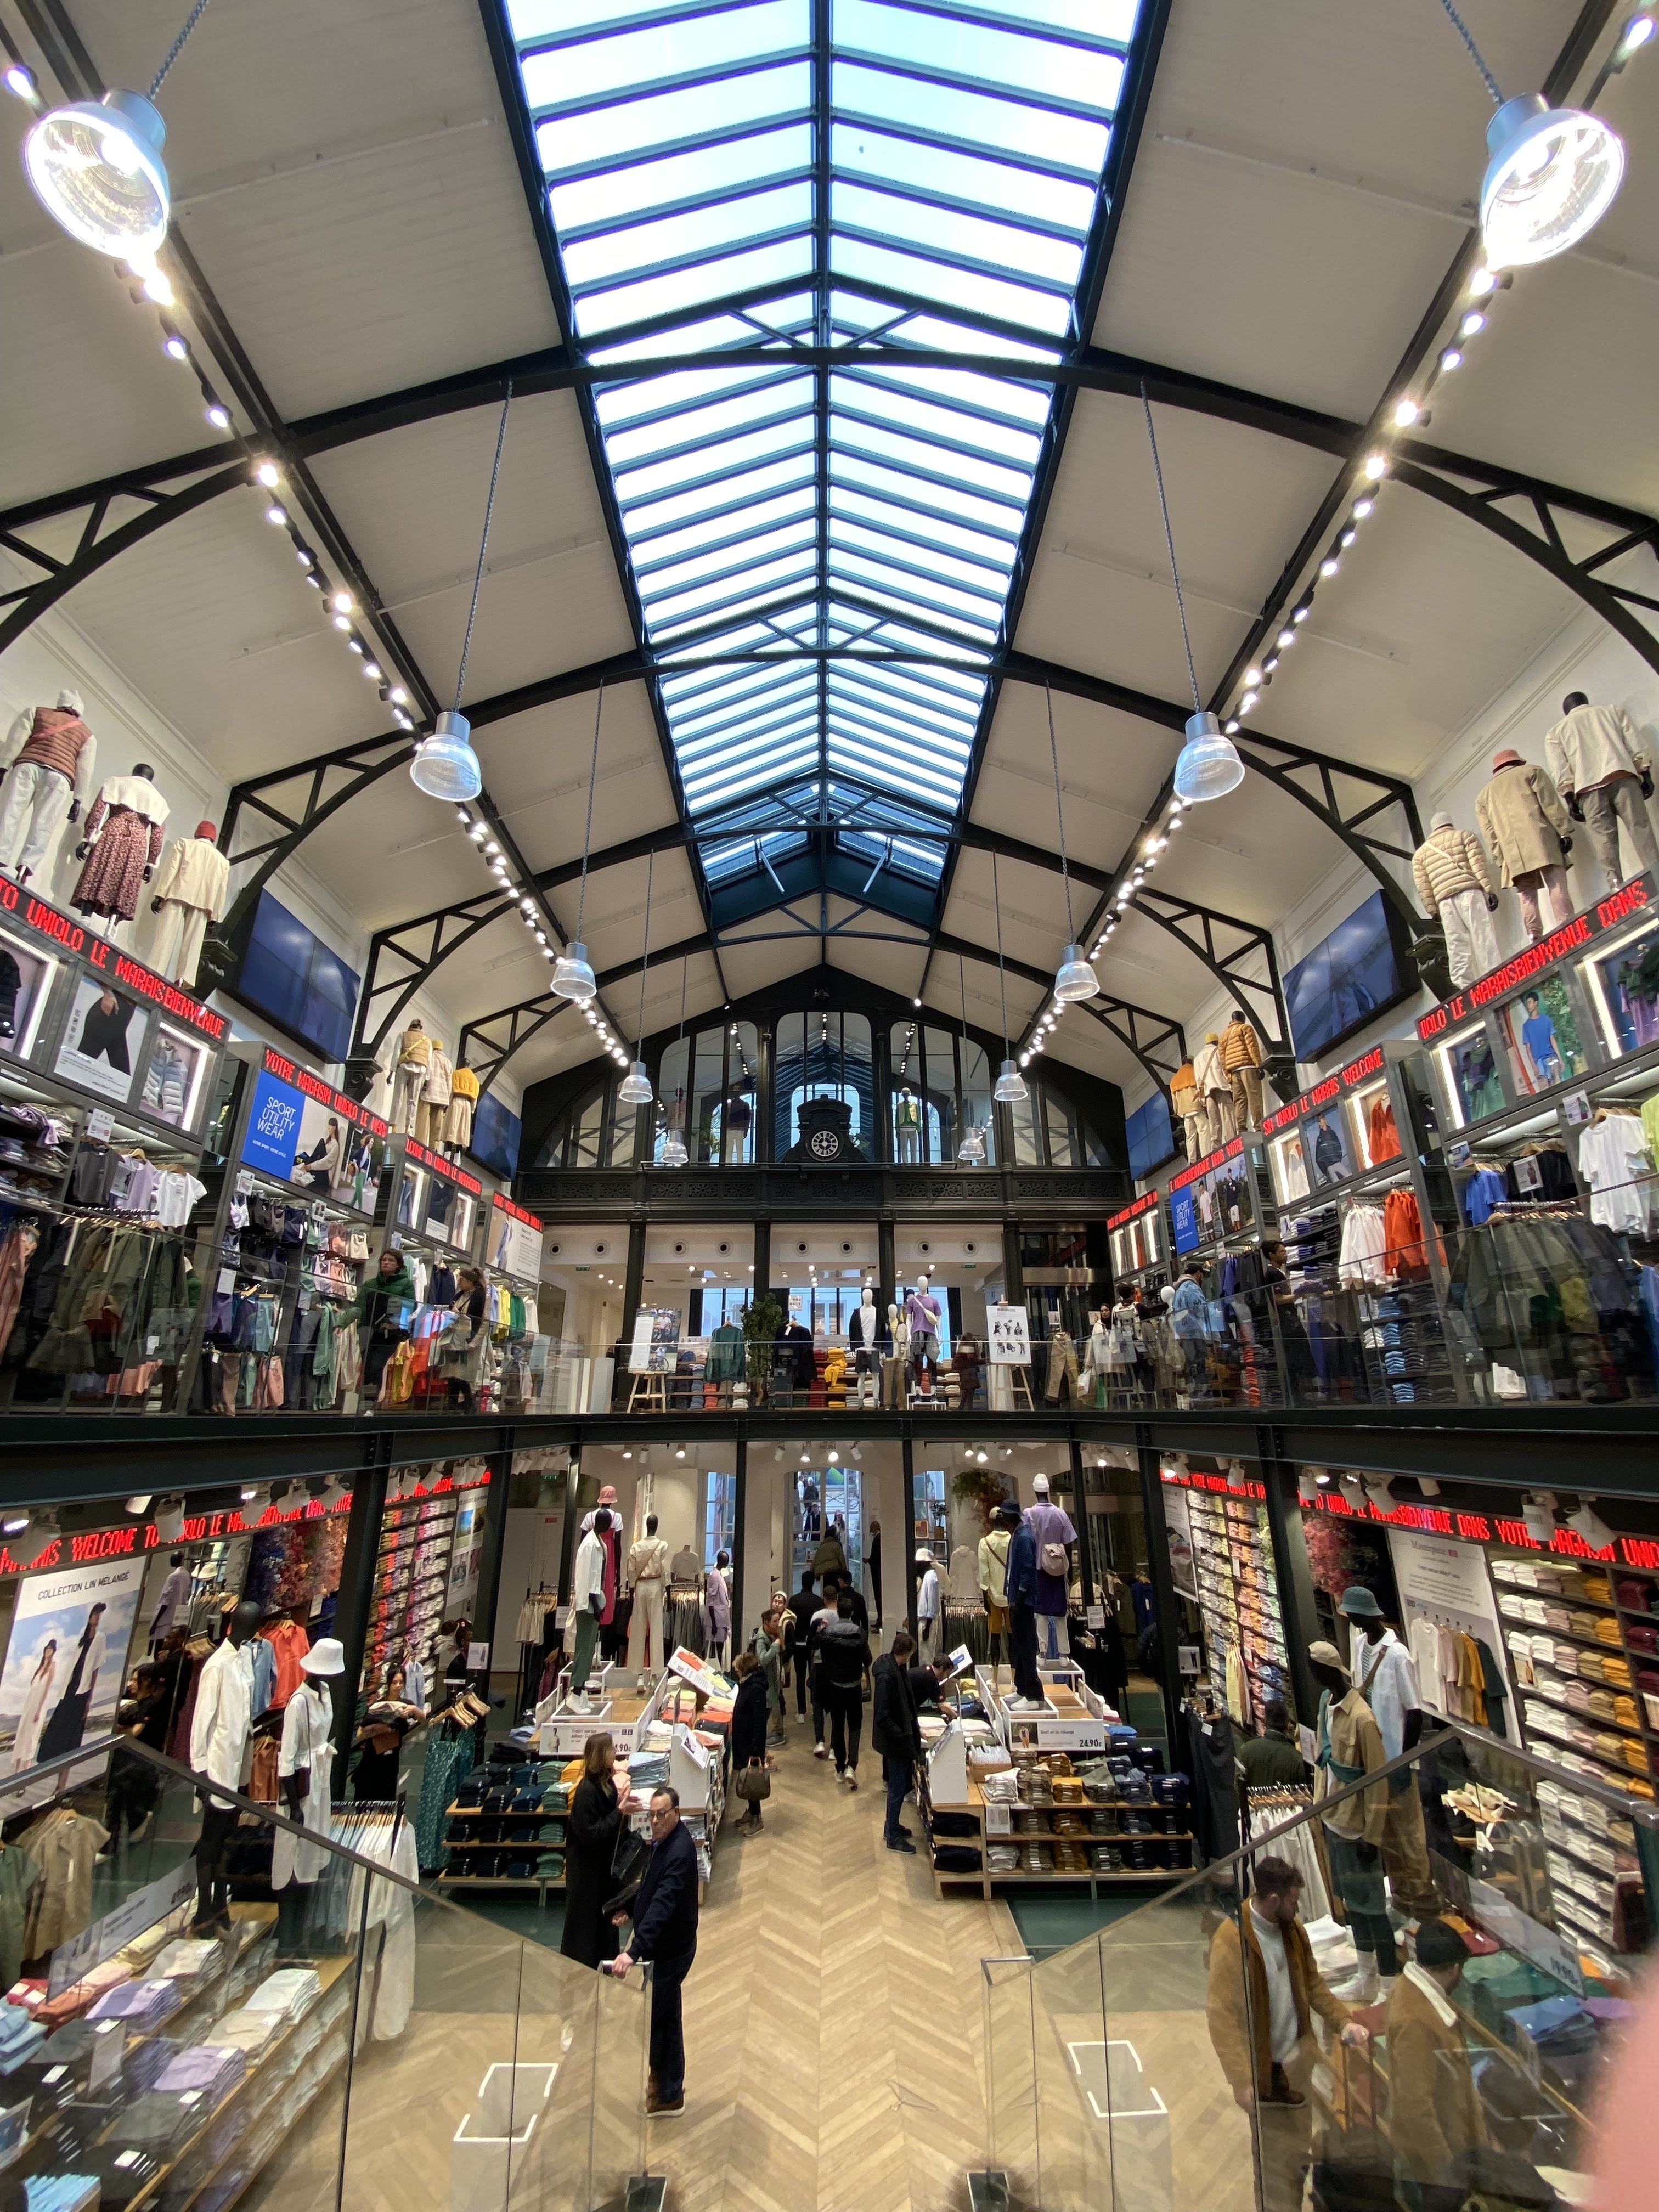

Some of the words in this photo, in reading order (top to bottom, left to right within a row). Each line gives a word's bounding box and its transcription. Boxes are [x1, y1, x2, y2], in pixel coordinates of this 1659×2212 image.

[27, 899, 84, 951] UNIQLO
[90, 940, 110, 969] LE
[1451, 996, 1466, 1020] LE
[1596, 880, 1648, 928] DANS
[266, 1049, 295, 1082] VOTRE
[297, 1070, 332, 1104] MAGASIN
[334, 1093, 358, 1121] UNIQLO
[359, 1109, 369, 1127] LE
[1276, 1103, 1299, 1127] UNIQLO
[1300, 1095, 1310, 1113] LE
[1312, 1077, 1340, 1106] MARAIS
[1342, 1048, 1384, 1086] WELCOME
[262, 1107, 295, 1131] UTILITY
[267, 1097, 296, 1119] SPORT
[257, 1118, 284, 1141] WEAR
[1176, 1199, 1189, 1214] SPORT
[1176, 1207, 1190, 1222] UTILITY
[1176, 1218, 1188, 1231] WEAR
[72, 1528, 137, 1561] WELCOME
[210, 1515, 224, 1536] LE
[1457, 1513, 1491, 1541] DANS
[38, 1582, 82, 1600] COLLECTION
[84, 1579, 97, 1590] LIN
[98, 1570, 130, 1587] MÉLANGÉ
